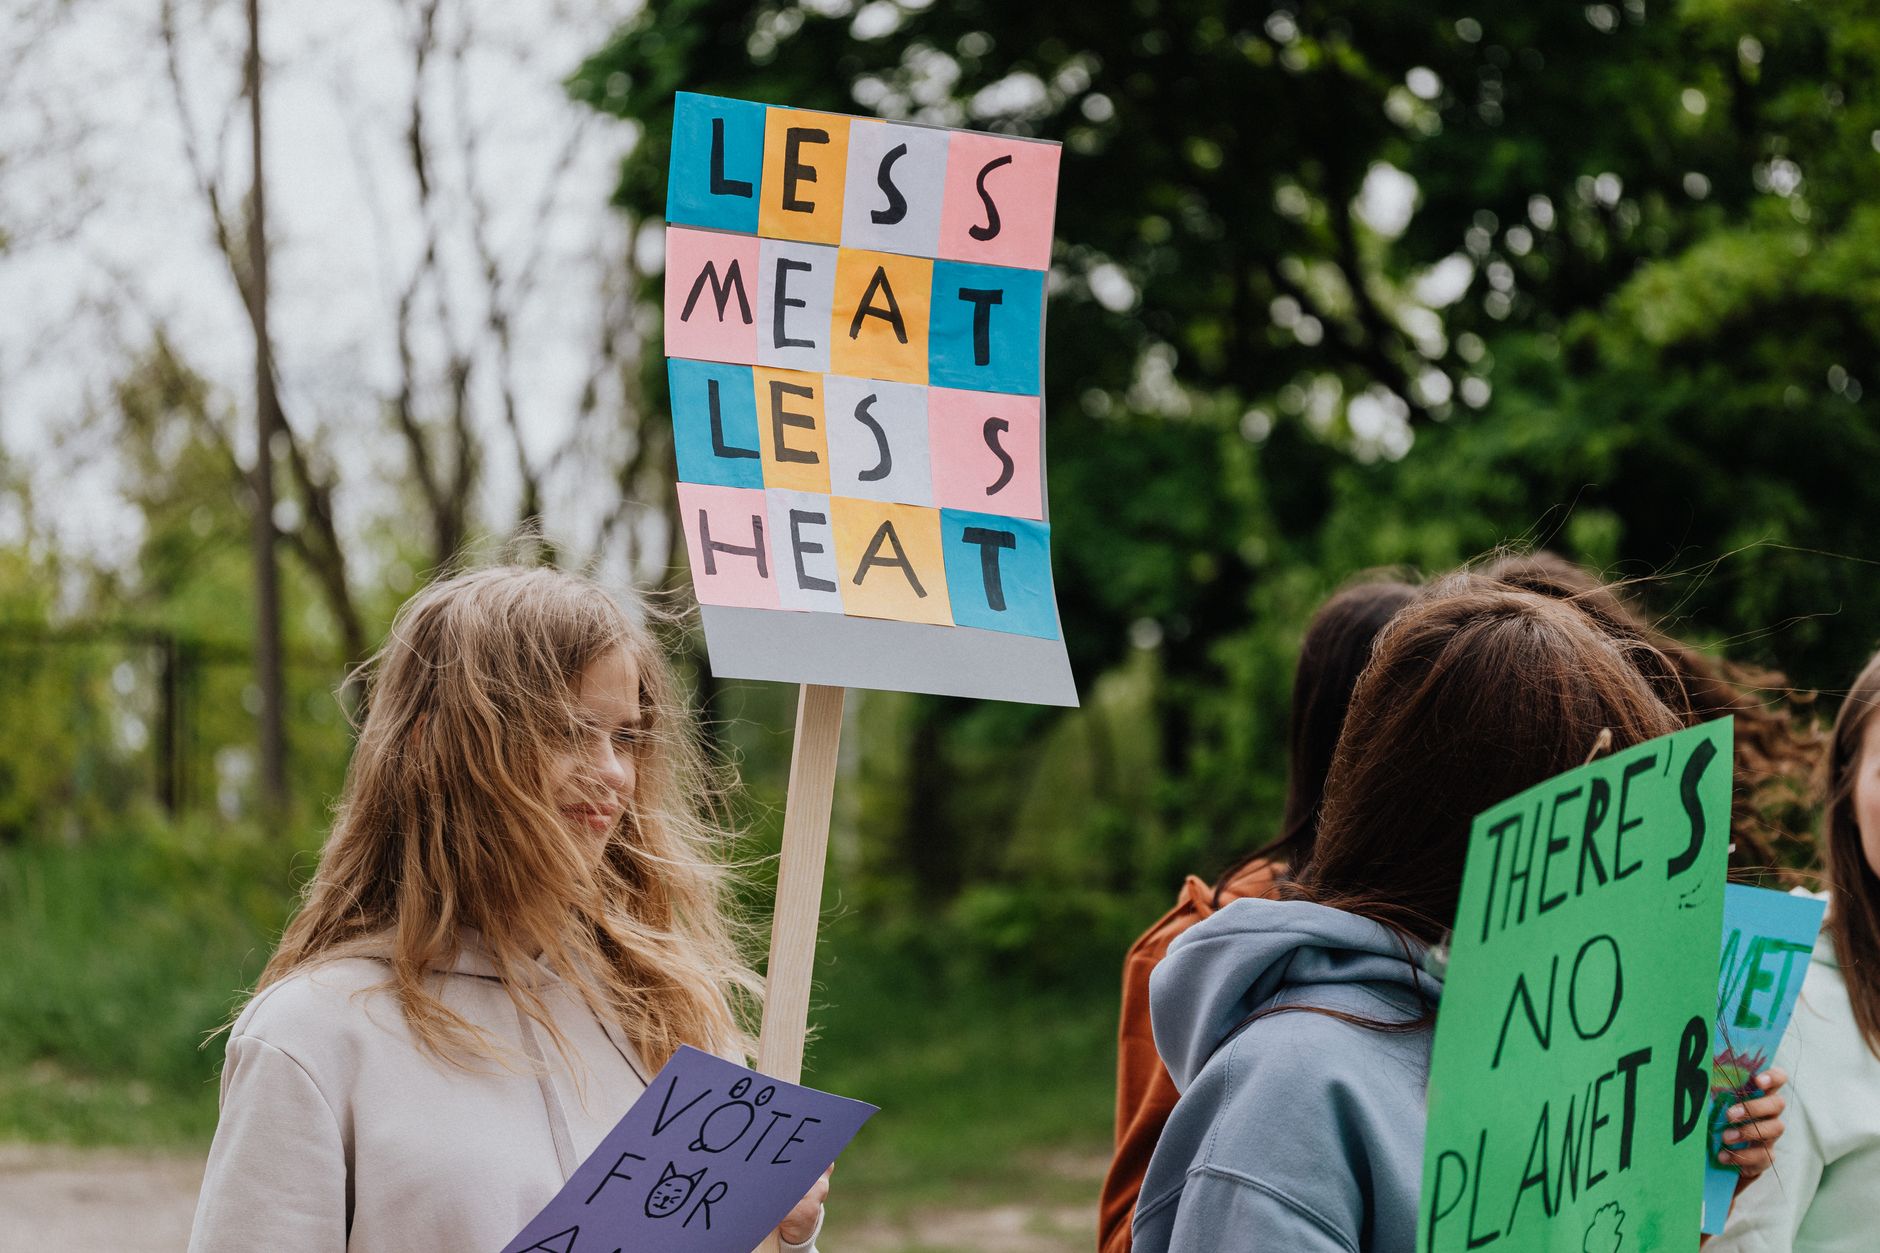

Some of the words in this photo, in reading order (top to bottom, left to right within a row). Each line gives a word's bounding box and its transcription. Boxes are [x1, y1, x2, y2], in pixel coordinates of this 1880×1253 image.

[710, 118, 1012, 242] LESS
[680, 257, 1004, 367] MEAT
[708, 379, 1015, 496] LESS
[699, 508, 1017, 612] HEAT
[1481, 737, 1718, 944] THERE'S
[1491, 934, 1624, 1070] NO
[651, 1076, 822, 1165] VOTE
[1427, 1046, 1653, 1253] PLANET
[1673, 1015, 1710, 1145] B
[585, 1151, 729, 1230] FOR
